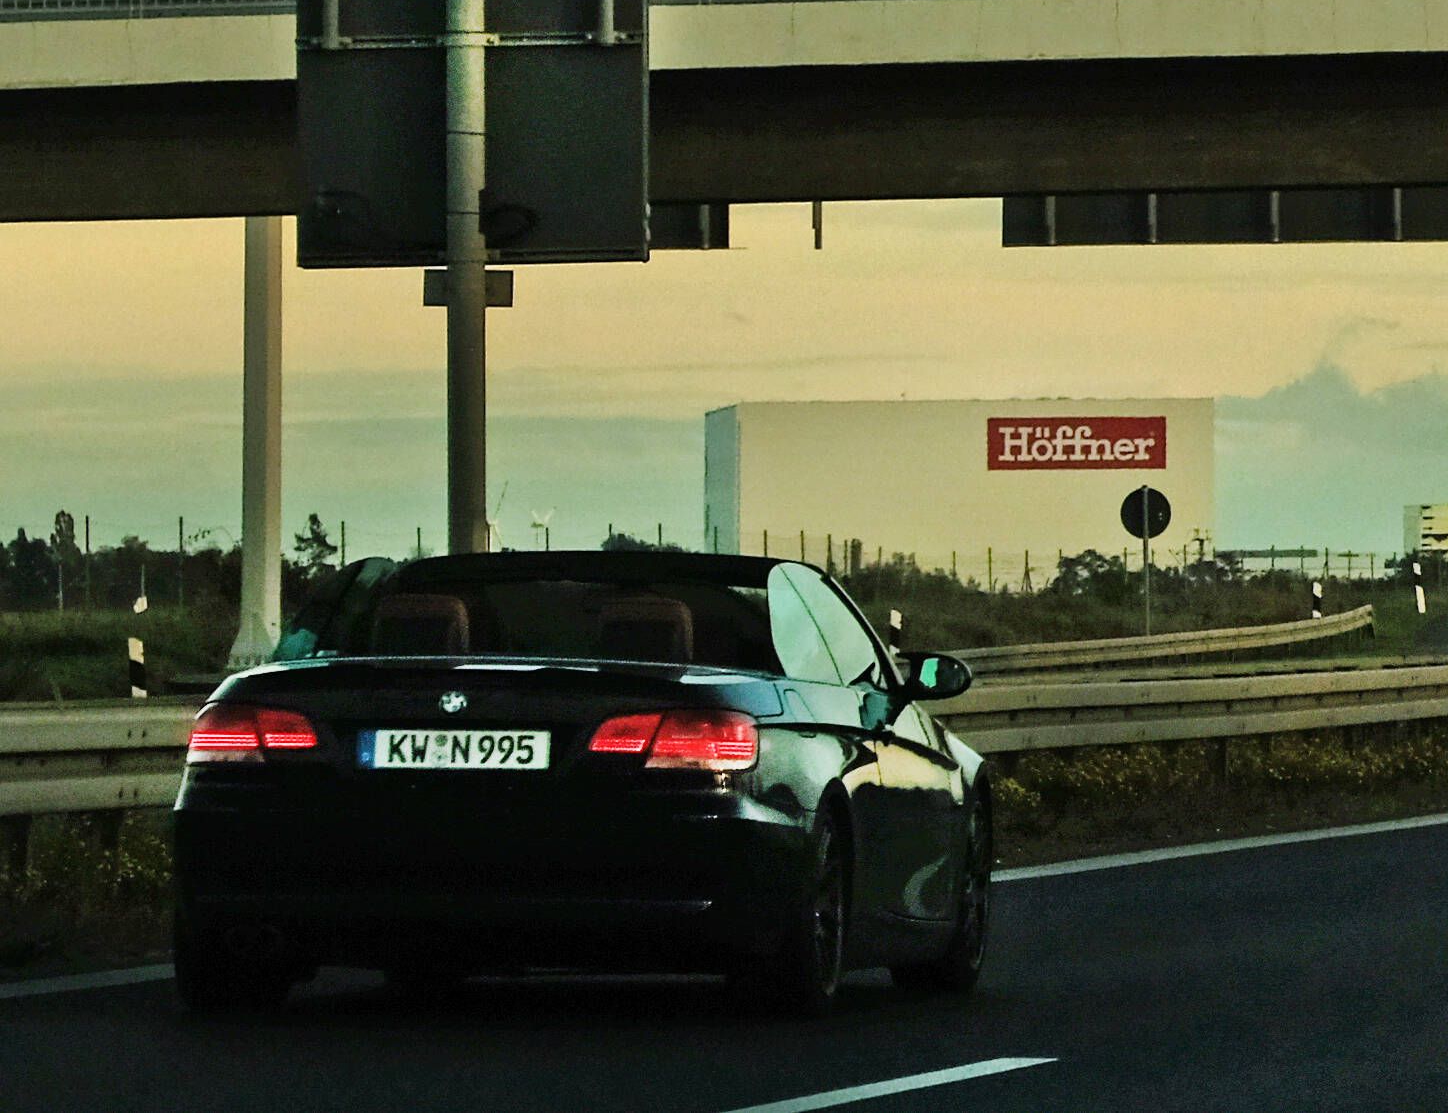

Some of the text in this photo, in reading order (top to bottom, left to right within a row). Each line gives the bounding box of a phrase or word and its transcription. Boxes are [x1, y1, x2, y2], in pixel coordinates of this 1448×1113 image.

[997, 425, 1156, 462] Höffner
[387, 734, 536, 765] KW N 995
